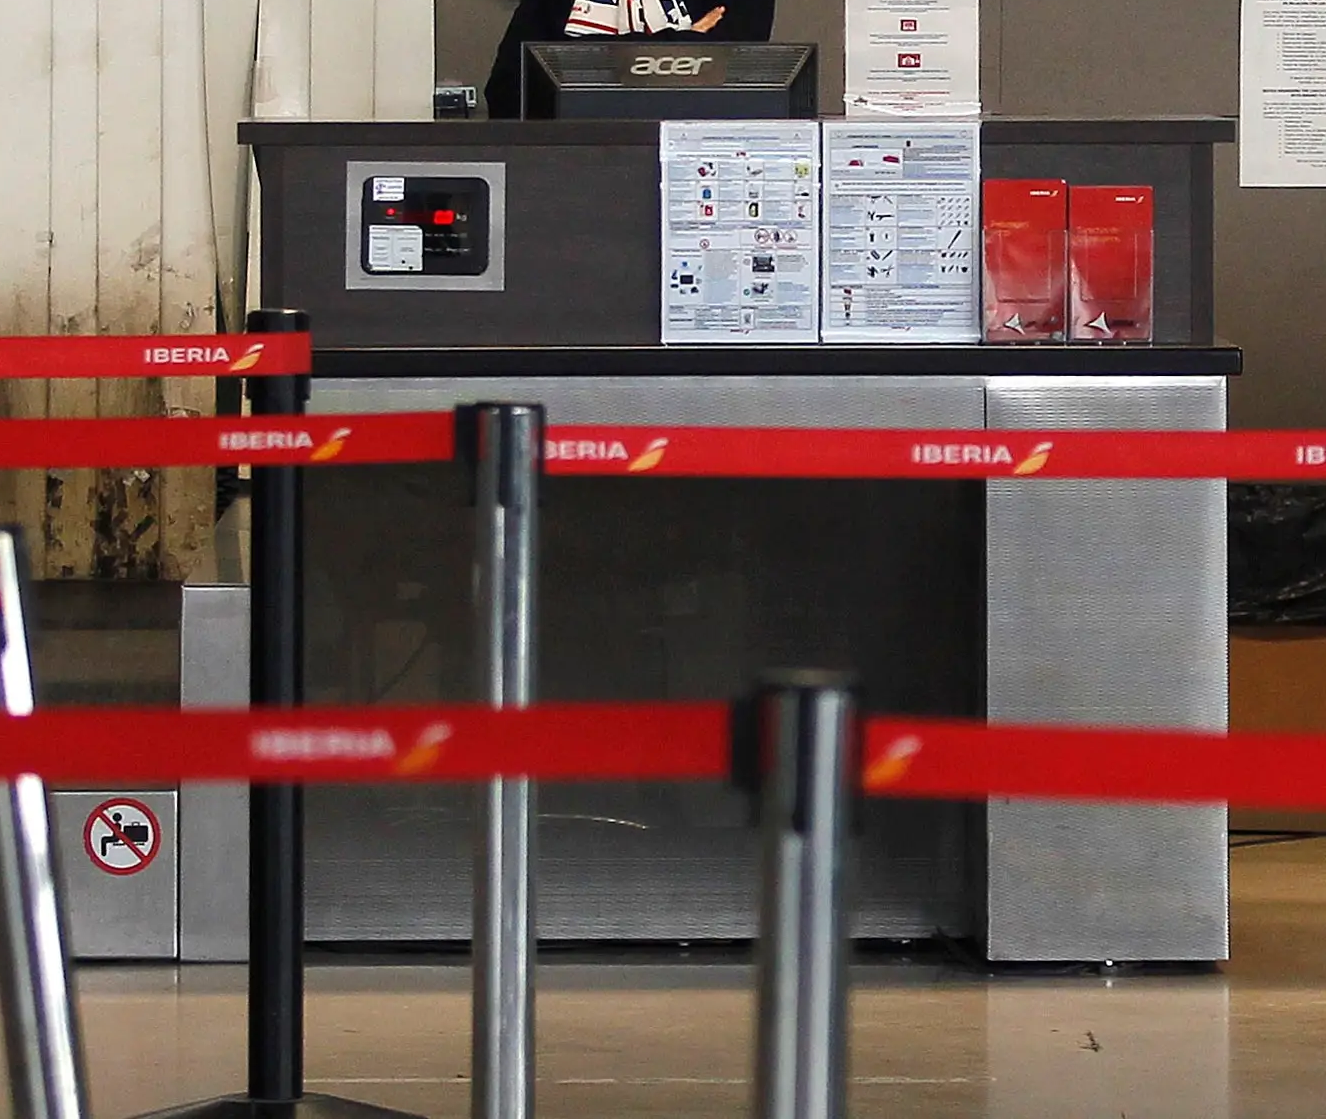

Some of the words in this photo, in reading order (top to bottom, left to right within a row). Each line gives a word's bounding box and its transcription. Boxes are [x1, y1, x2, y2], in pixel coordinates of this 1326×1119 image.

[630, 55, 714, 76] acer
[144, 347, 230, 365] IBERIA
[219, 430, 313, 451] IBERIA
[544, 439, 629, 461] BERIA
[912, 443, 1013, 465] IBERIA
[249, 729, 397, 761] IBERIA
